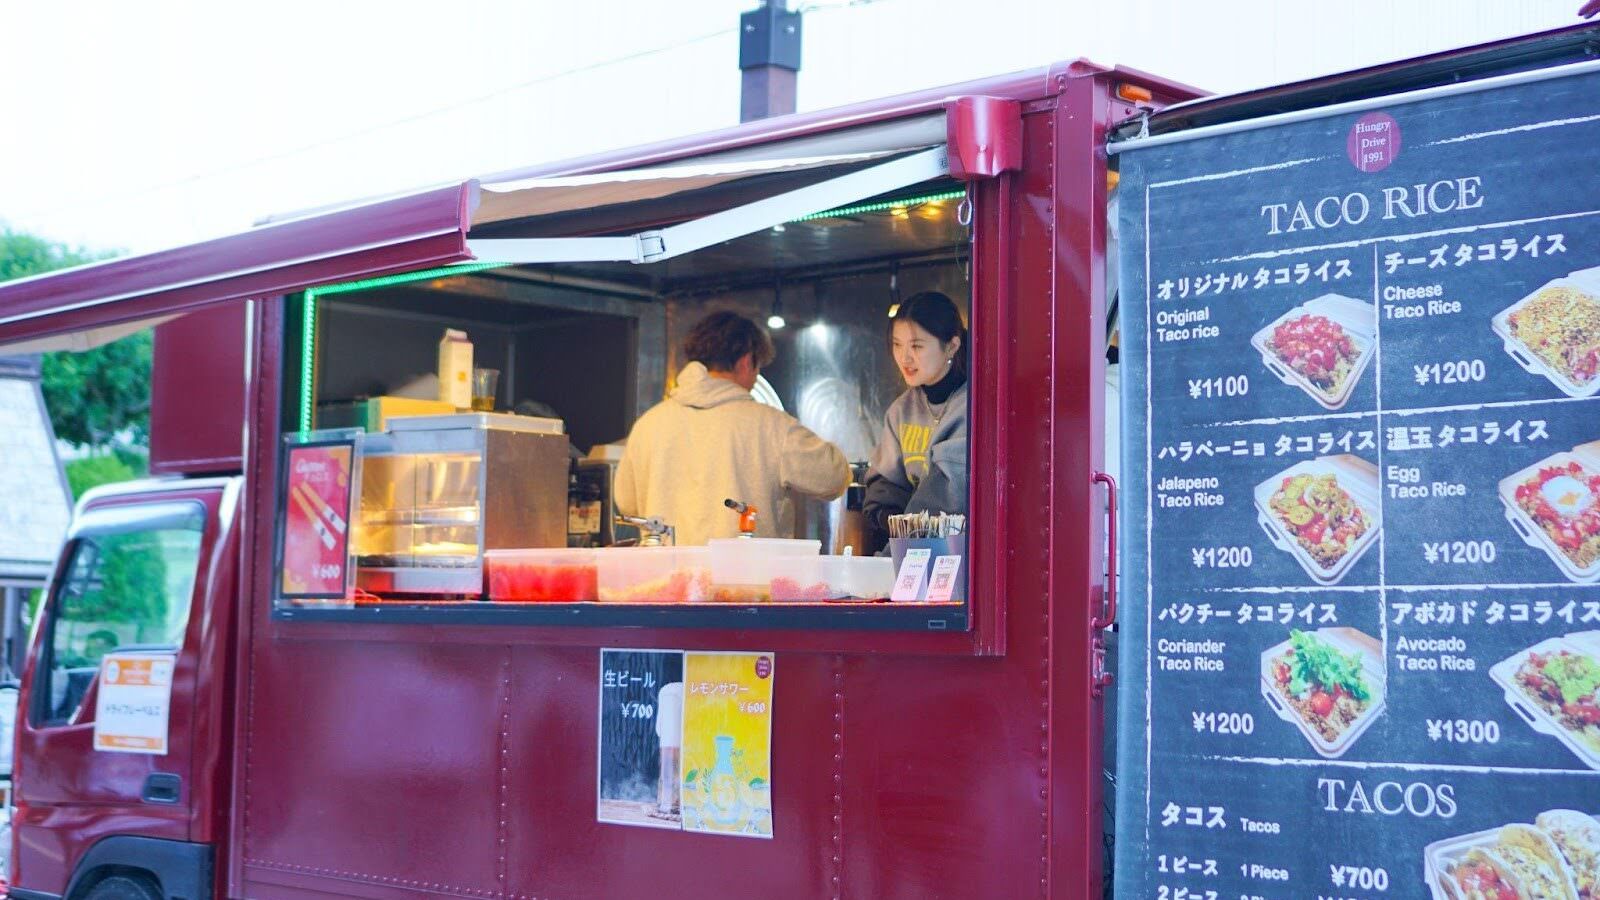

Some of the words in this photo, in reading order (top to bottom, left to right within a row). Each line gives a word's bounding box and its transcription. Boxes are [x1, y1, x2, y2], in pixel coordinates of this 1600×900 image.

[1356, 121, 1391, 133] Hungry
[1362, 137, 1386, 148] Drive
[1363, 151, 1384, 163] 1991
[1261, 192, 1370, 236] TACO
[1382, 176, 1486, 221] RICE
[1384, 284, 1443, 302] Cheese
[1156, 305, 1209, 326] Original
[1384, 303, 1424, 320] Taco
[1428, 299, 1462, 317] Rice
[1157, 326, 1189, 343] Taco
[1192, 323, 1220, 340] rice
[1413, 360, 1486, 386] ¥1200
[1188, 375, 1249, 400] ¥1100
[1158, 439, 1265, 463] ハラペーニョ
[1275, 430, 1377, 457] タコライス
[1158, 475, 1219, 493] Jalapeno
[1387, 466, 1420, 485] Egg
[1158, 493, 1192, 508] Taco
[1195, 492, 1224, 507] Rice
[1388, 483, 1429, 500] Taco
[1432, 481, 1466, 498] Rice
[1192, 546, 1253, 569] ¥1200
[1424, 541, 1496, 565] ¥1200
[1392, 600, 1478, 625] アボカド
[1486, 600, 1600, 625] タコライス
[1158, 638, 1226, 655] Coriander
[1396, 636, 1466, 653] Avocado
[1158, 655, 1192, 671] Taco
[1195, 656, 1224, 672] Rice
[1397, 655, 1438, 671] Taco
[1441, 655, 1475, 671] Rice
[604, 669, 656, 688] 生ビール
[690, 681, 749, 695] レモンサワー
[621, 702, 654, 719] ¥700
[1192, 711, 1254, 735] ¥1200
[1426, 719, 1500, 744] ¥1300
[1318, 778, 1458, 818] TACOS
[1161, 802, 1227, 829] タコス
[1240, 818, 1281, 834] Tacos
[1240, 864, 1248, 878] 1
[1251, 864, 1289, 881] Piece
[1330, 863, 1389, 891] ¥700
